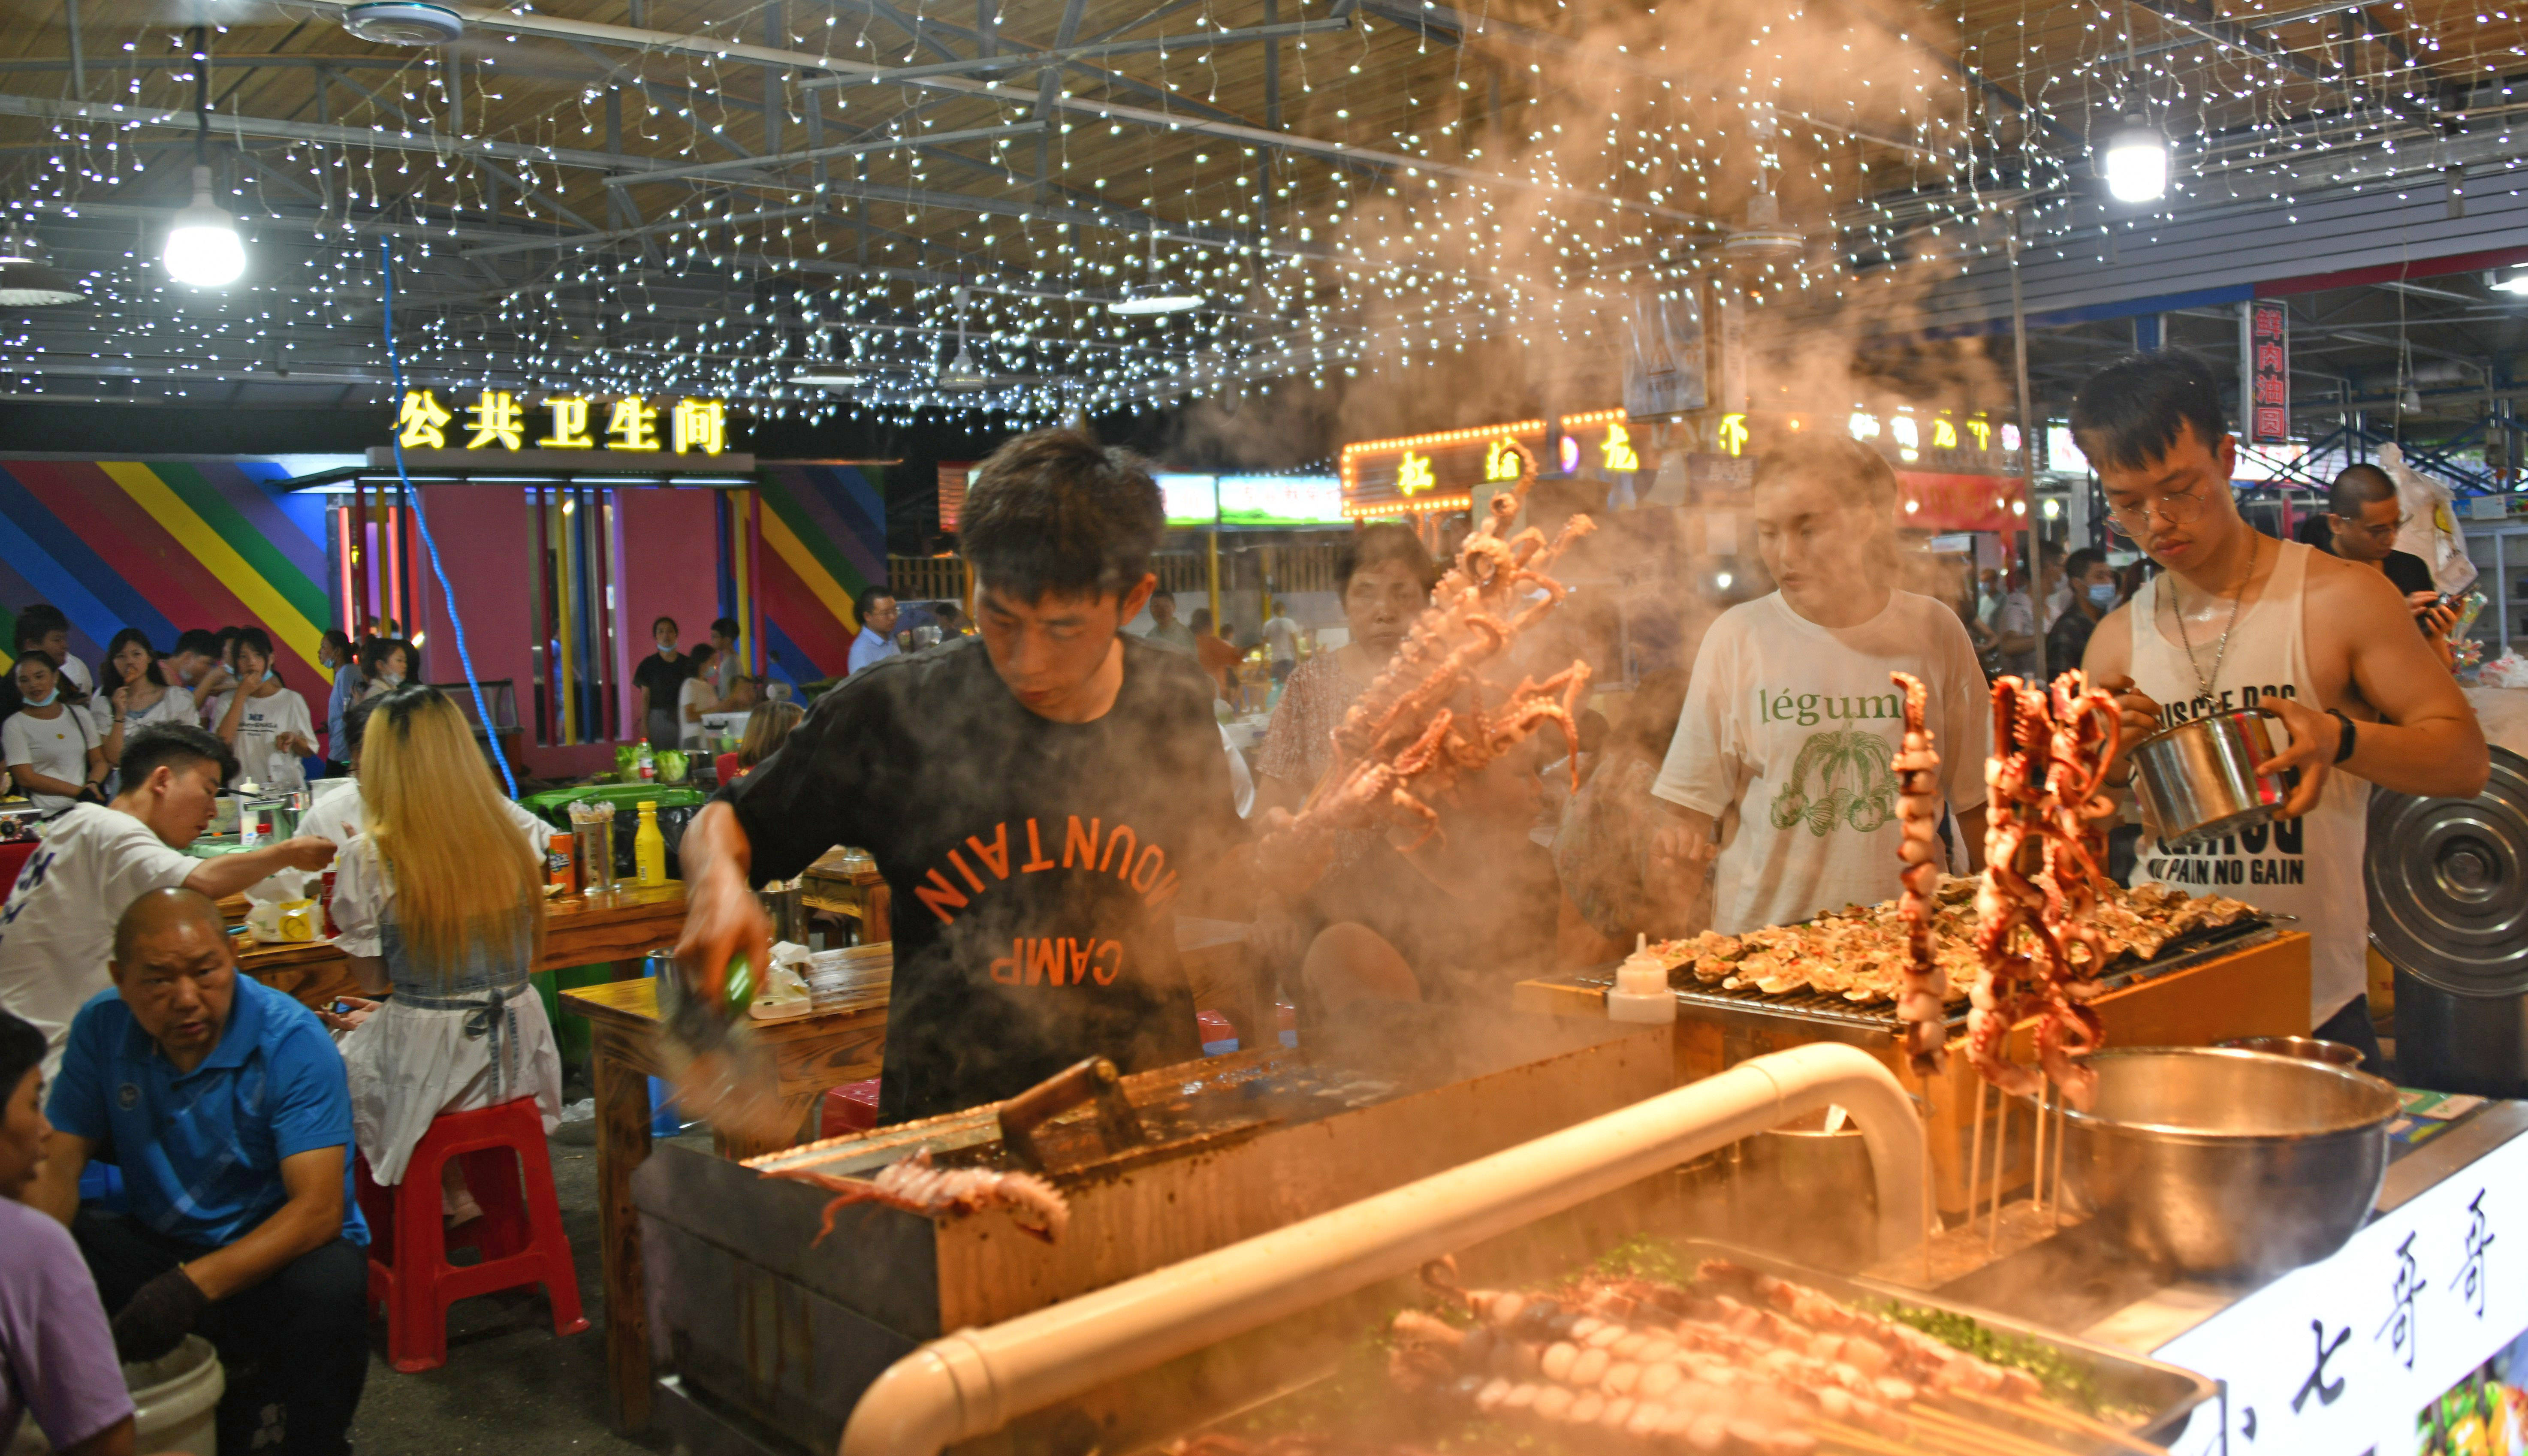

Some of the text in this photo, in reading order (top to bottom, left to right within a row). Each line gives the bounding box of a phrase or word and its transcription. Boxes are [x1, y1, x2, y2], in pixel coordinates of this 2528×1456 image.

[2255, 307, 2284, 438] 鲜肉油圆
[393, 390, 726, 455] 公共卫生间
[1759, 687, 1902, 726] légum
[914, 815, 1180, 925] MOUNTAIN
[2166, 859, 2208, 884] PAIN
[2214, 859, 2244, 885] NO
[2251, 859, 2304, 885] GAIN
[990, 937, 1123, 987] CAMP
